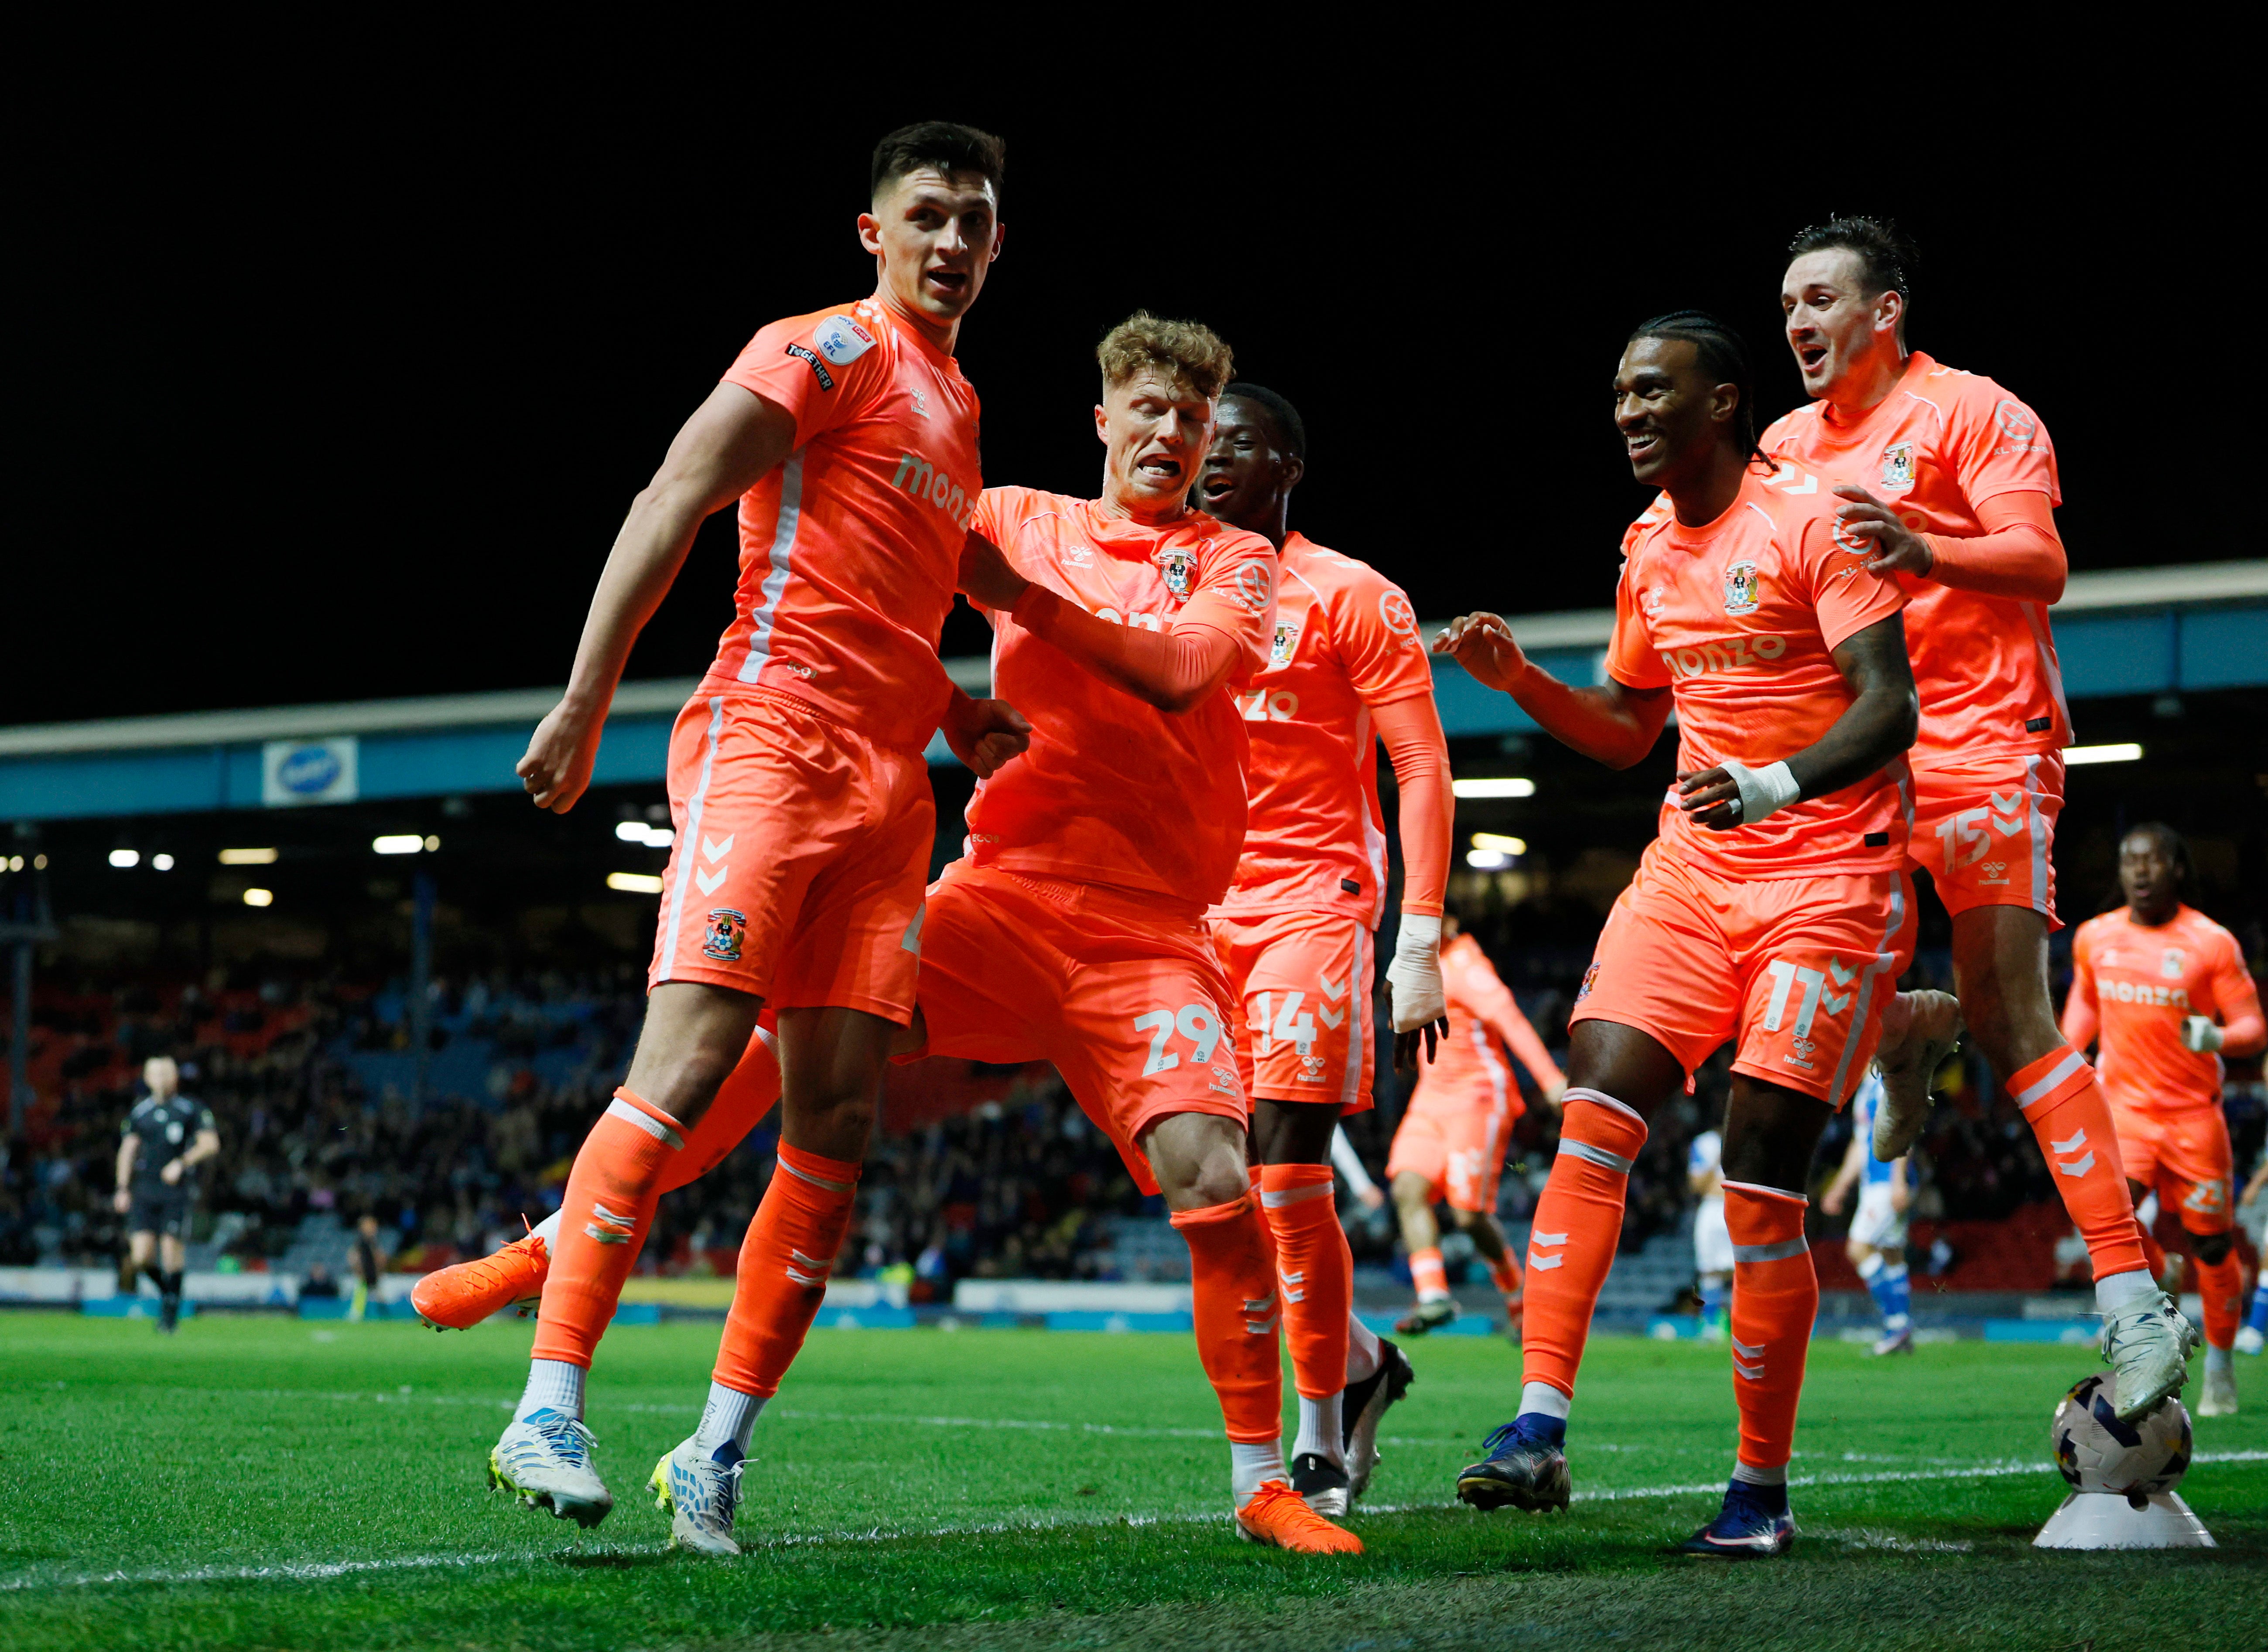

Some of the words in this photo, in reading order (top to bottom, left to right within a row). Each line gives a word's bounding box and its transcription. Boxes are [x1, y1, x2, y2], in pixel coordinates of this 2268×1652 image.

[838, 317, 853, 325] sky
[854, 326, 870, 341] bet
[823, 340, 836, 357] EFL
[788, 345, 831, 390] TOGETHER
[1994, 447, 2010, 456] XL
[1061, 558, 1094, 570] hummel
[1209, 586, 1227, 597] XL
[1935, 806, 1991, 876] 15
[1763, 959, 1825, 1039] 11
[1257, 991, 1317, 1055] 14
[1134, 1004, 1220, 1078] 29
[1783, 1054, 1813, 1070] hummel
[1208, 1082, 1236, 1097] hummel
